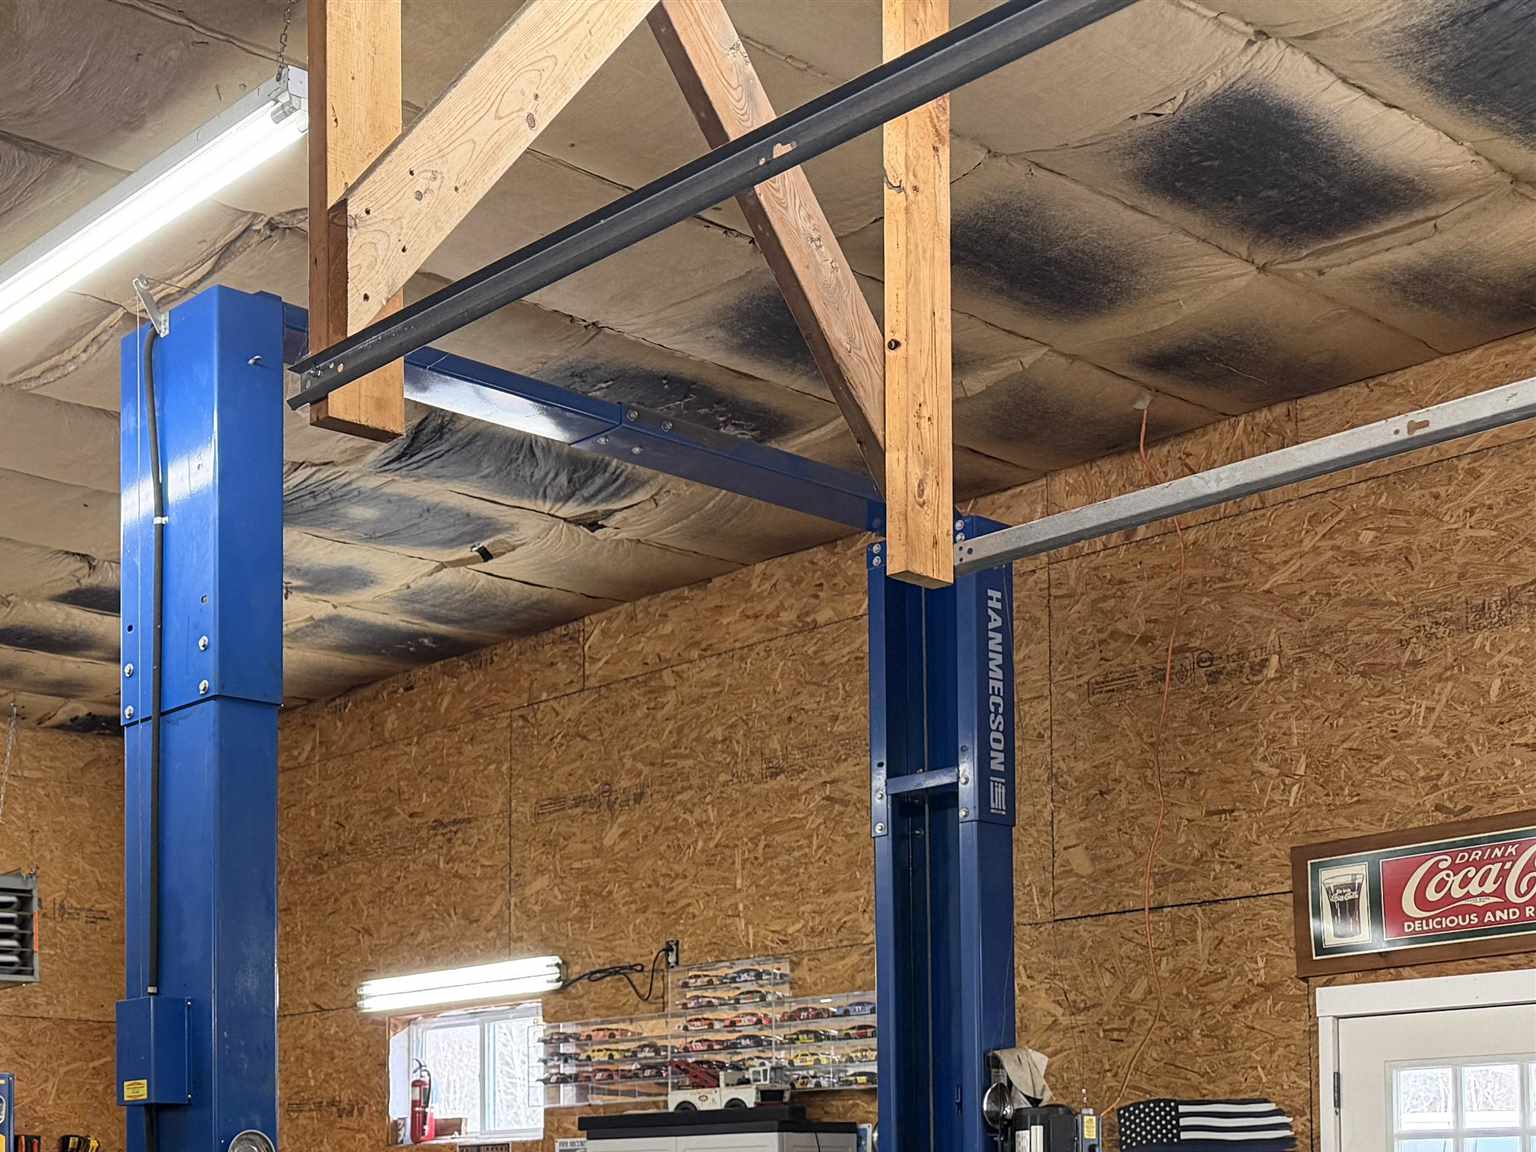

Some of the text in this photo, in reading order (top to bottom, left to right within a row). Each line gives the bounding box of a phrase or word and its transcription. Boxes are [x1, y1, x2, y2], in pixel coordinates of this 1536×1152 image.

[986, 588, 1005, 773] HANMECSON
[1455, 843, 1520, 865] DRINK
[1404, 909, 1479, 933] DELICIOUS
[1484, 907, 1521, 923] AND
